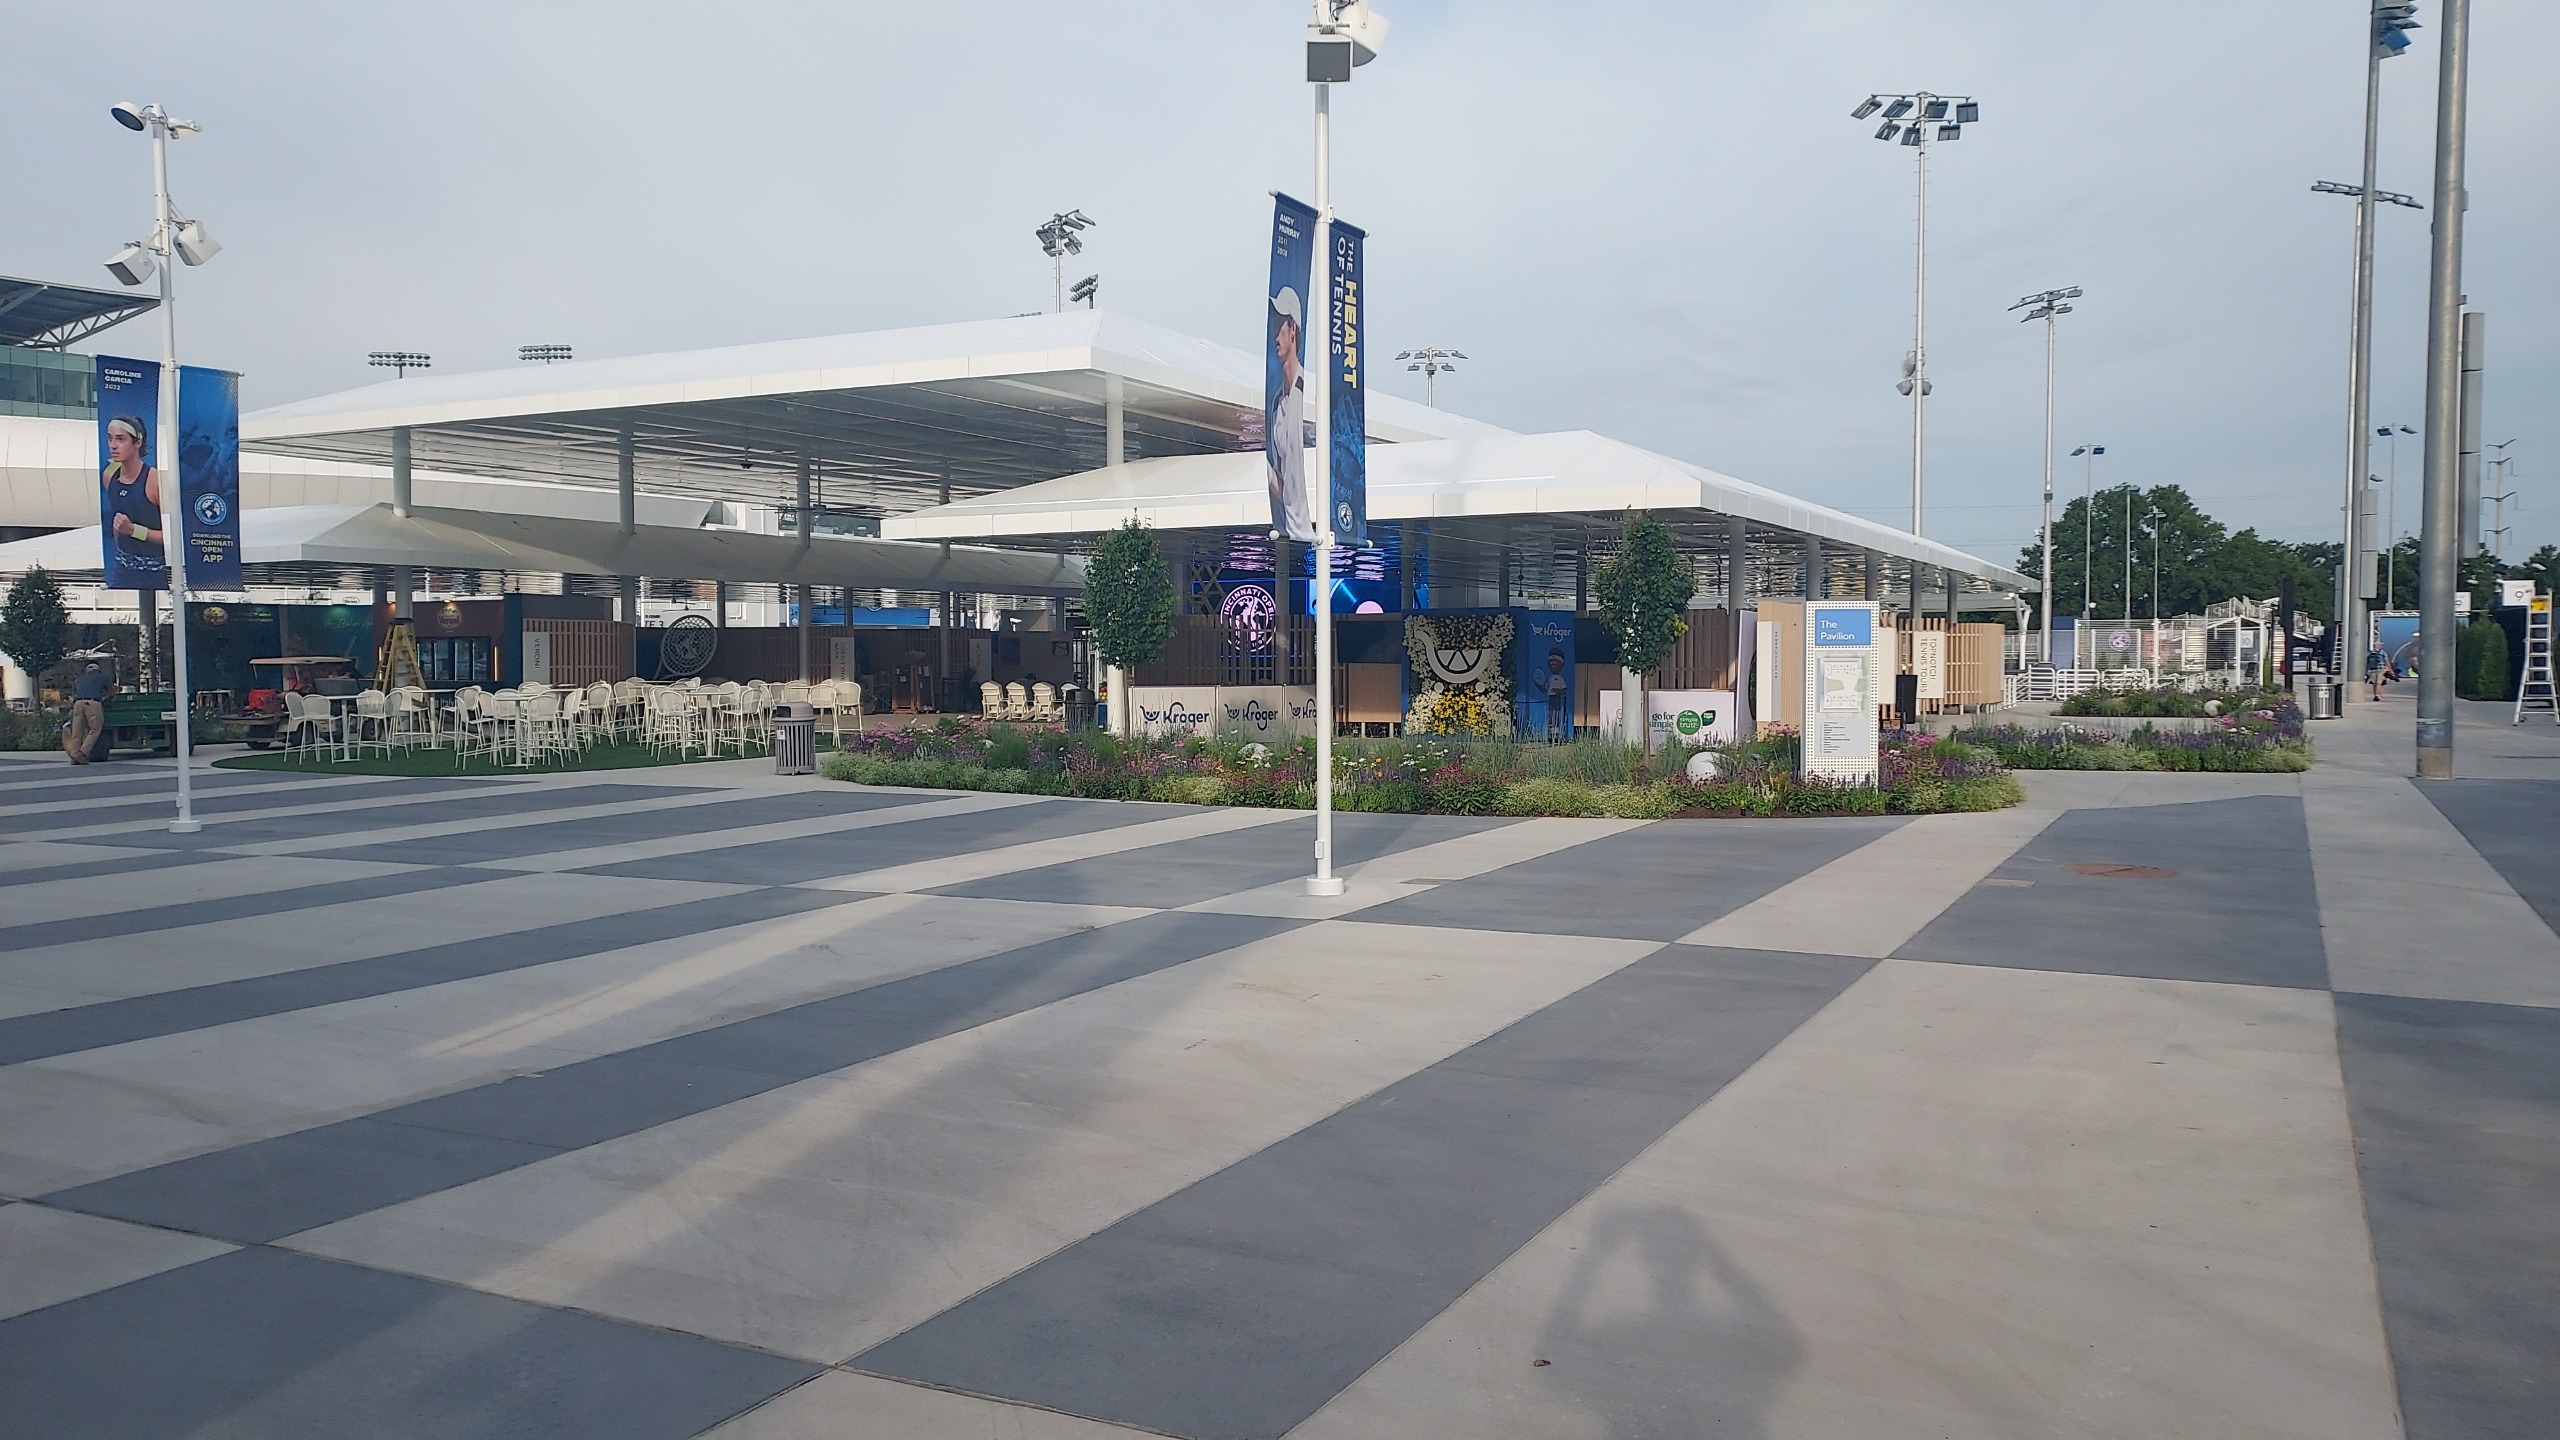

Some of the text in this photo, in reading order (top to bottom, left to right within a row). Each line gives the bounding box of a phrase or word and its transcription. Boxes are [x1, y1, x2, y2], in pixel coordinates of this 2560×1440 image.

[1279, 213, 1295, 226] ANDY
[1278, 224, 1301, 240] MURRAY
[1332, 236, 1346, 356] OF TENNIS
[1343, 241, 1357, 389] THE HEART
[104, 368, 142, 378] CAROLINE
[104, 375, 132, 384] GARCIA
[191, 539, 233, 547] CINCINNATI
[202, 554, 223, 563] APP
[2515, 591, 2524, 601] 9
[1820, 620, 1838, 629] The
[1543, 621, 1572, 642] Kroger
[1820, 632, 1855, 641] Pavilion
[1929, 638, 1937, 680] TOPNOTCH
[1920, 638, 1928, 693] TENNIS TOURS
[1162, 702, 1210, 727] Kroger
[1243, 699, 1279, 731] Kroger
[1652, 712, 1675, 721] go for
[1648, 720, 1674, 728] simple
